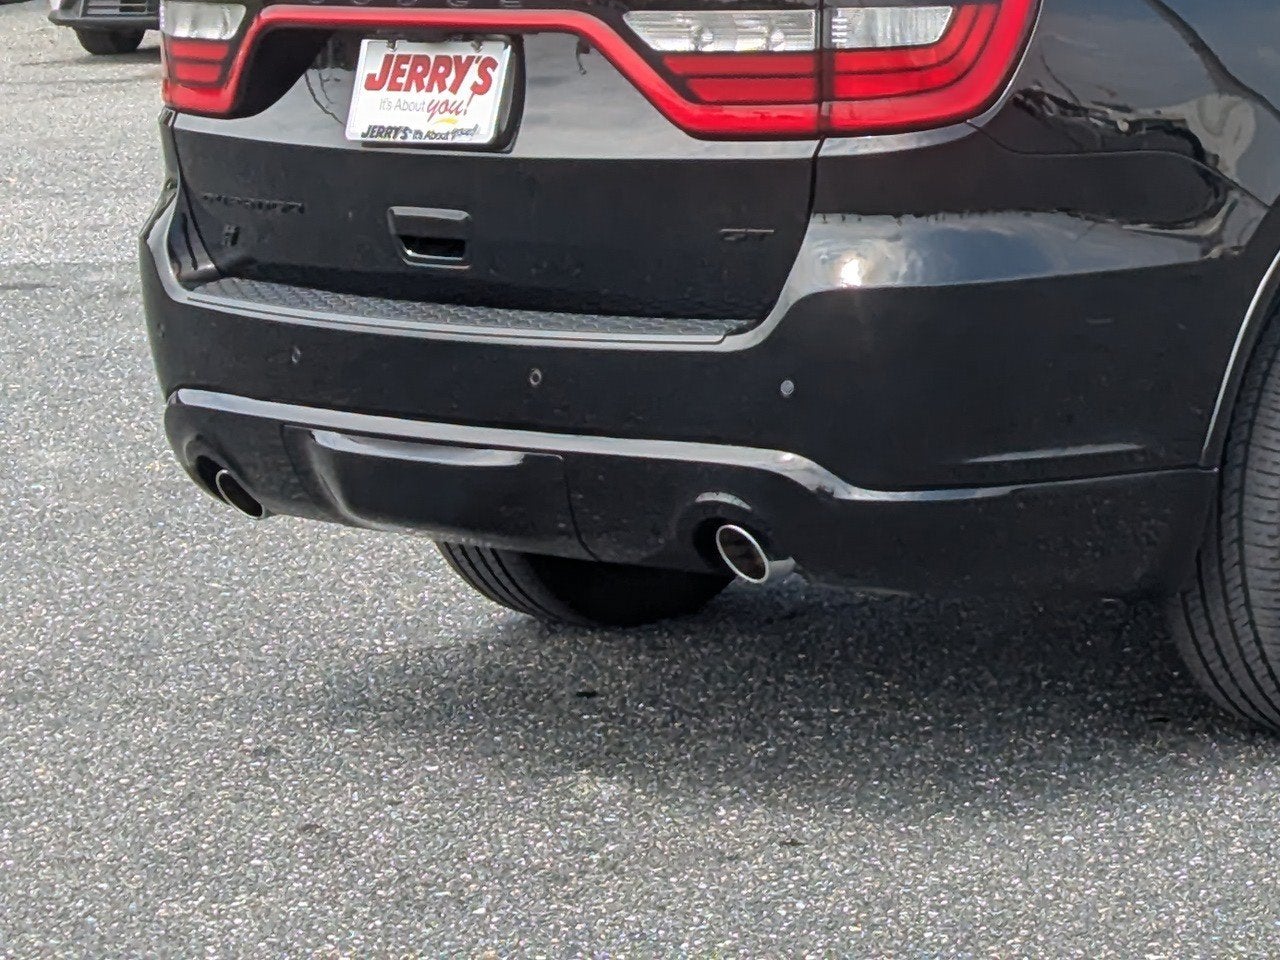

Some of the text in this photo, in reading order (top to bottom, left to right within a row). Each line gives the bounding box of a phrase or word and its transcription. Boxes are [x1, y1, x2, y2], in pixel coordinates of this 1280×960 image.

[364, 53, 499, 96] JERRY'S
[379, 91, 475, 122] It's About you!
[361, 124, 412, 140] JERRY'S
